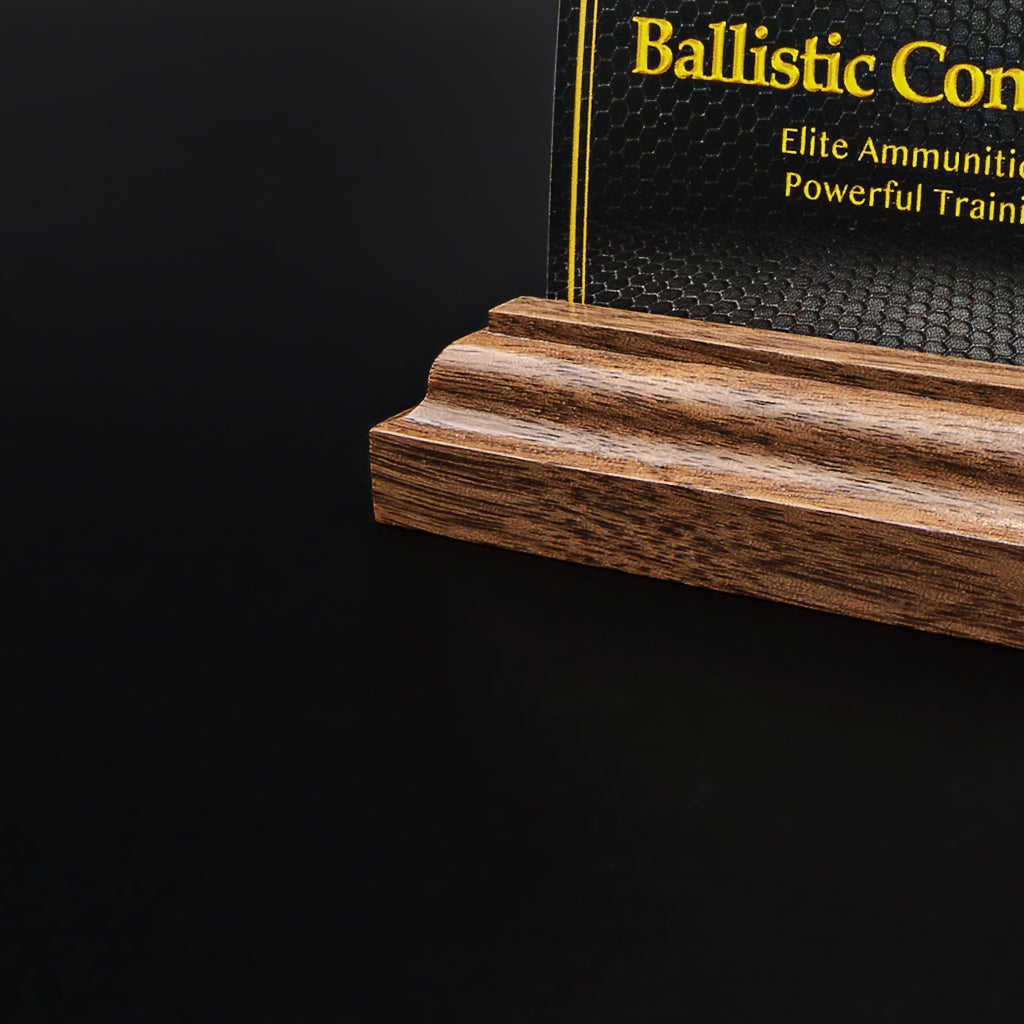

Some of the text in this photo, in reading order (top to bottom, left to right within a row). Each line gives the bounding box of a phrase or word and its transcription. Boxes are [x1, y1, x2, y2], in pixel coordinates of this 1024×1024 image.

[630, 15, 878, 98] Ballistic
[780, 125, 849, 160] Elite
[784, 171, 923, 214] Powerful
